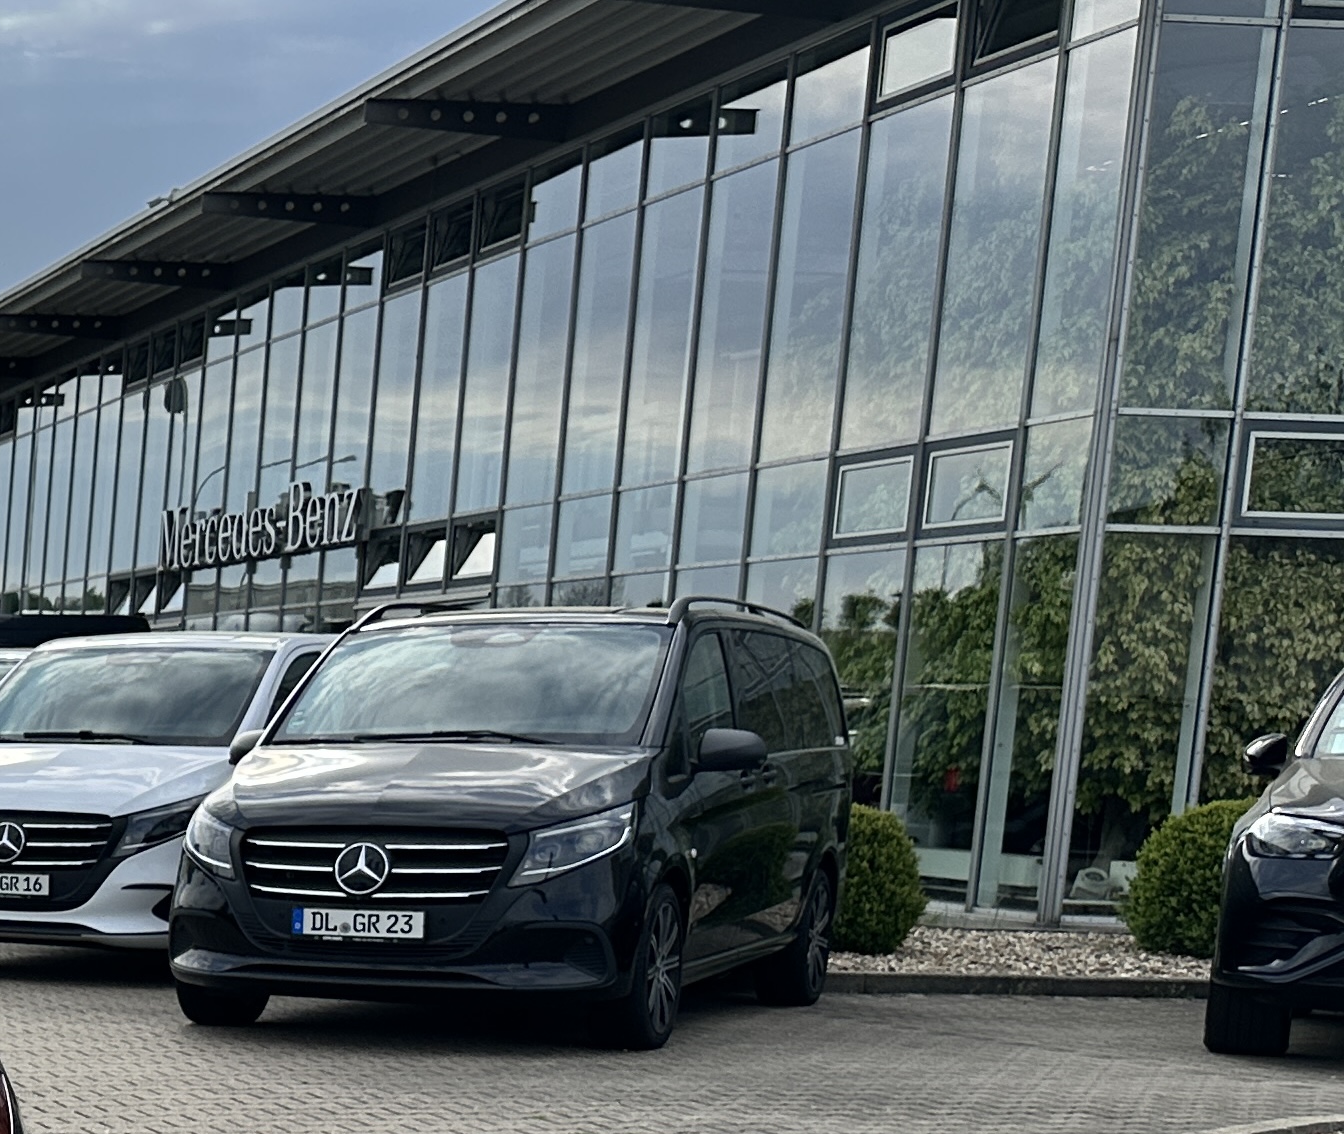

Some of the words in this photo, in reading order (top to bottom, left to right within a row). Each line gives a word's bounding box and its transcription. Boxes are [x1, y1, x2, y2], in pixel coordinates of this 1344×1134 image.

[157, 481, 363, 571] Mercedes-Benz
[0, 875, 20, 892] GR
[23, 876, 43, 893] 16
[310, 911, 338, 932] DL
[353, 913, 380, 934] GR
[386, 914, 413, 934] 23
